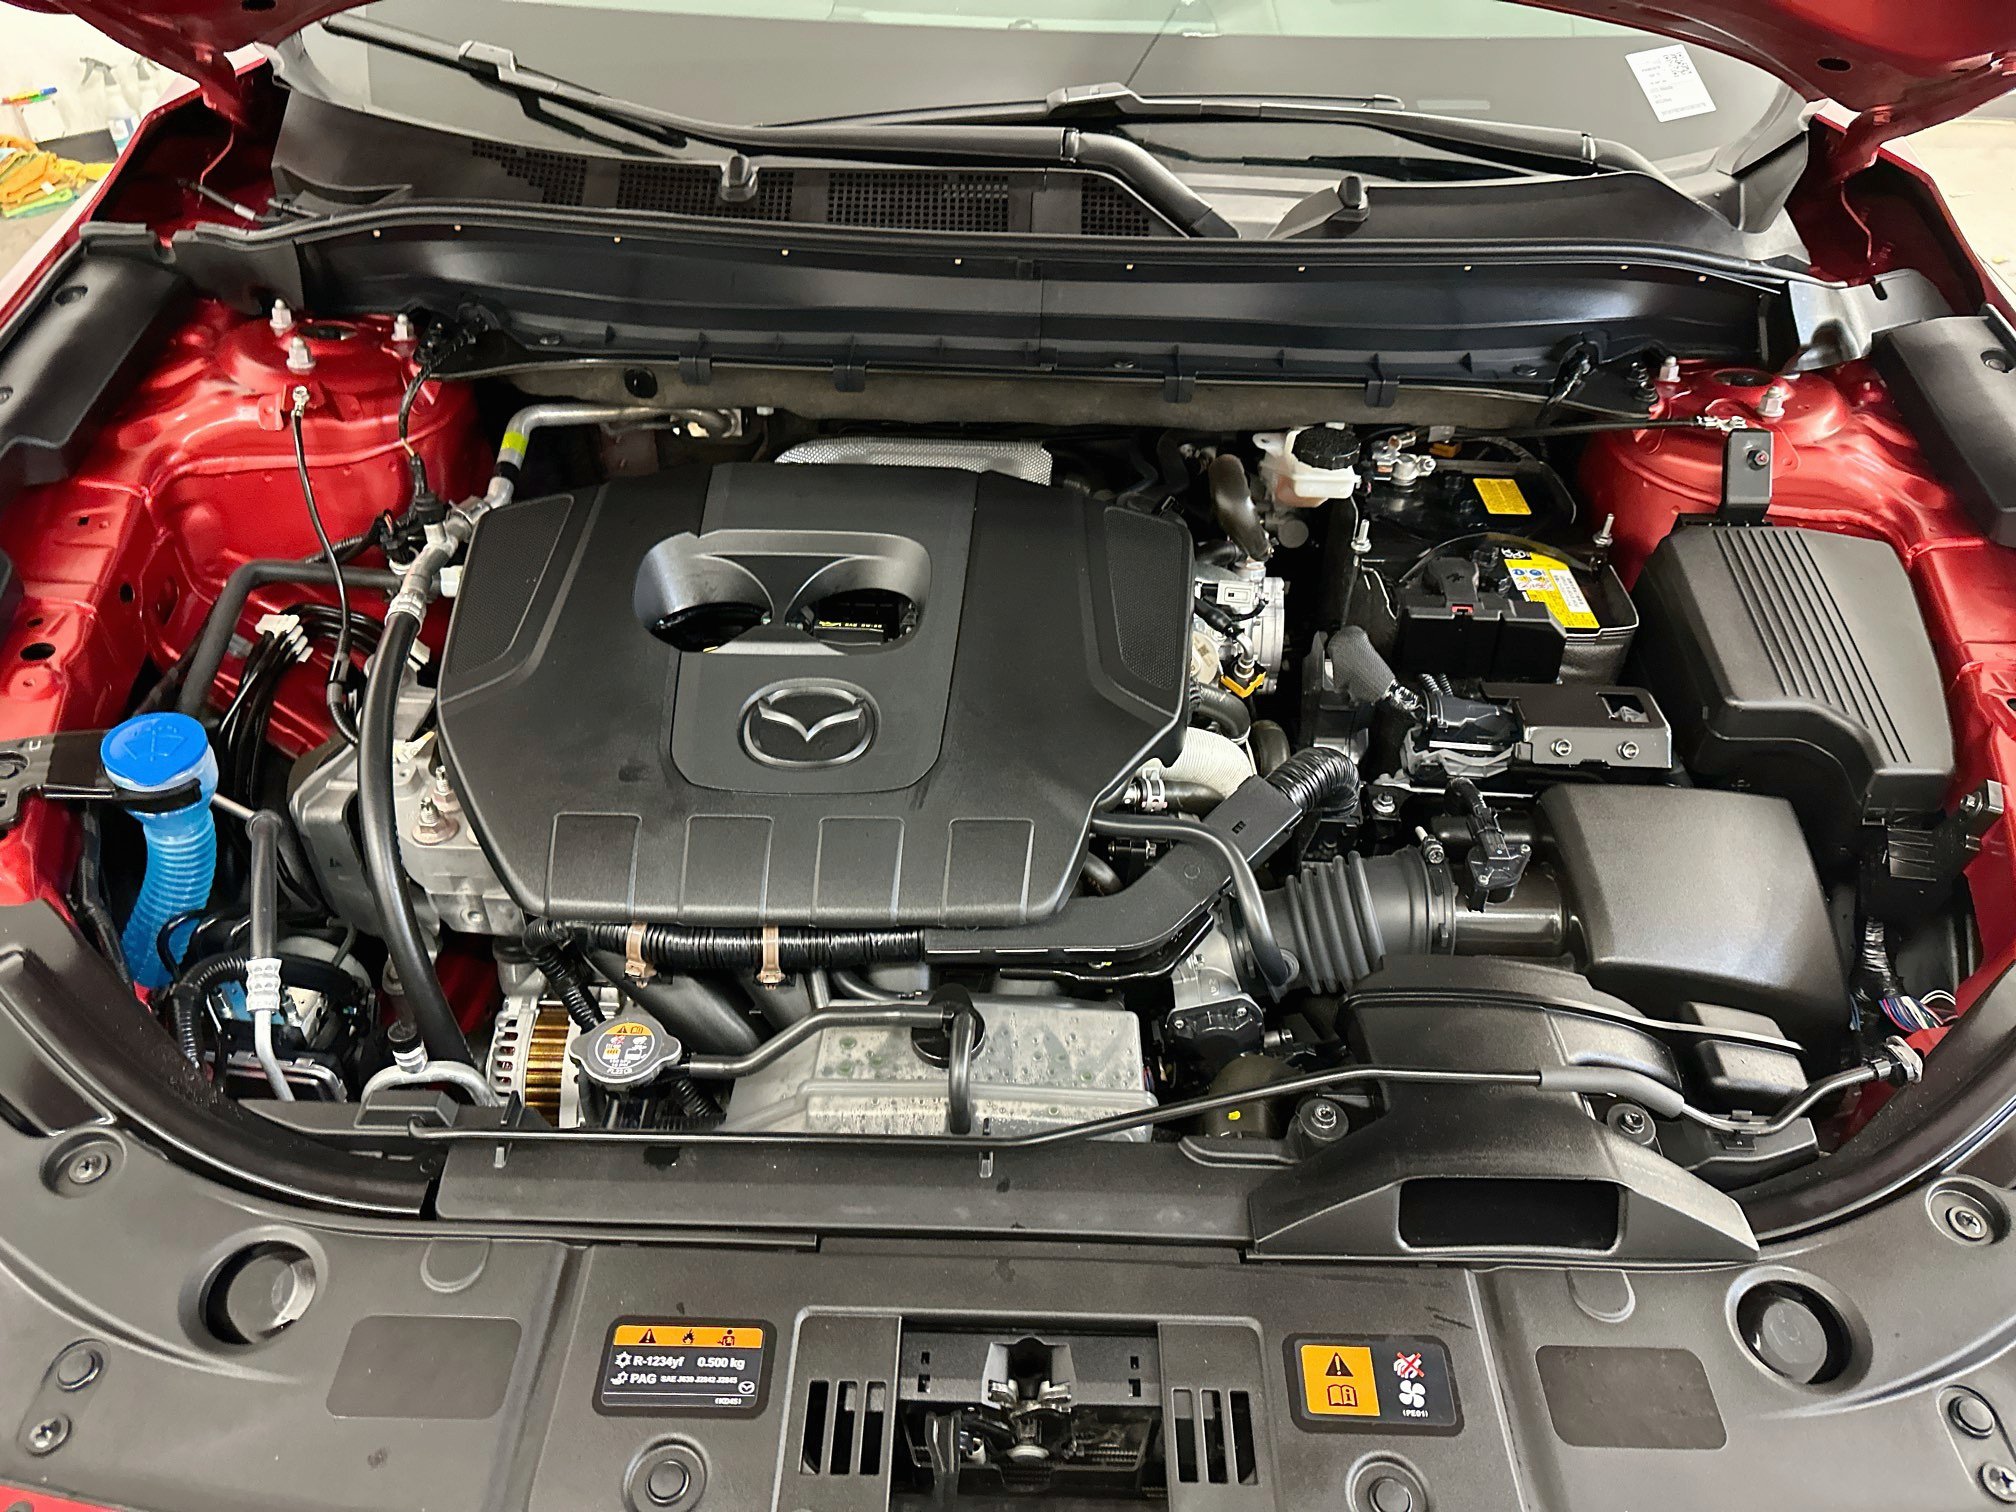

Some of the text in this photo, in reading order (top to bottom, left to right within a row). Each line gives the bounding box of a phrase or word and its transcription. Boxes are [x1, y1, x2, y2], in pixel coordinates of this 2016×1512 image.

[633, 1356, 746, 1370] R-1234yf 0.500 kg
[630, 1373, 657, 1384] PAG
[660, 1375, 677, 1383] SAE
[1402, 1409, 1429, 1418] (PE01)
